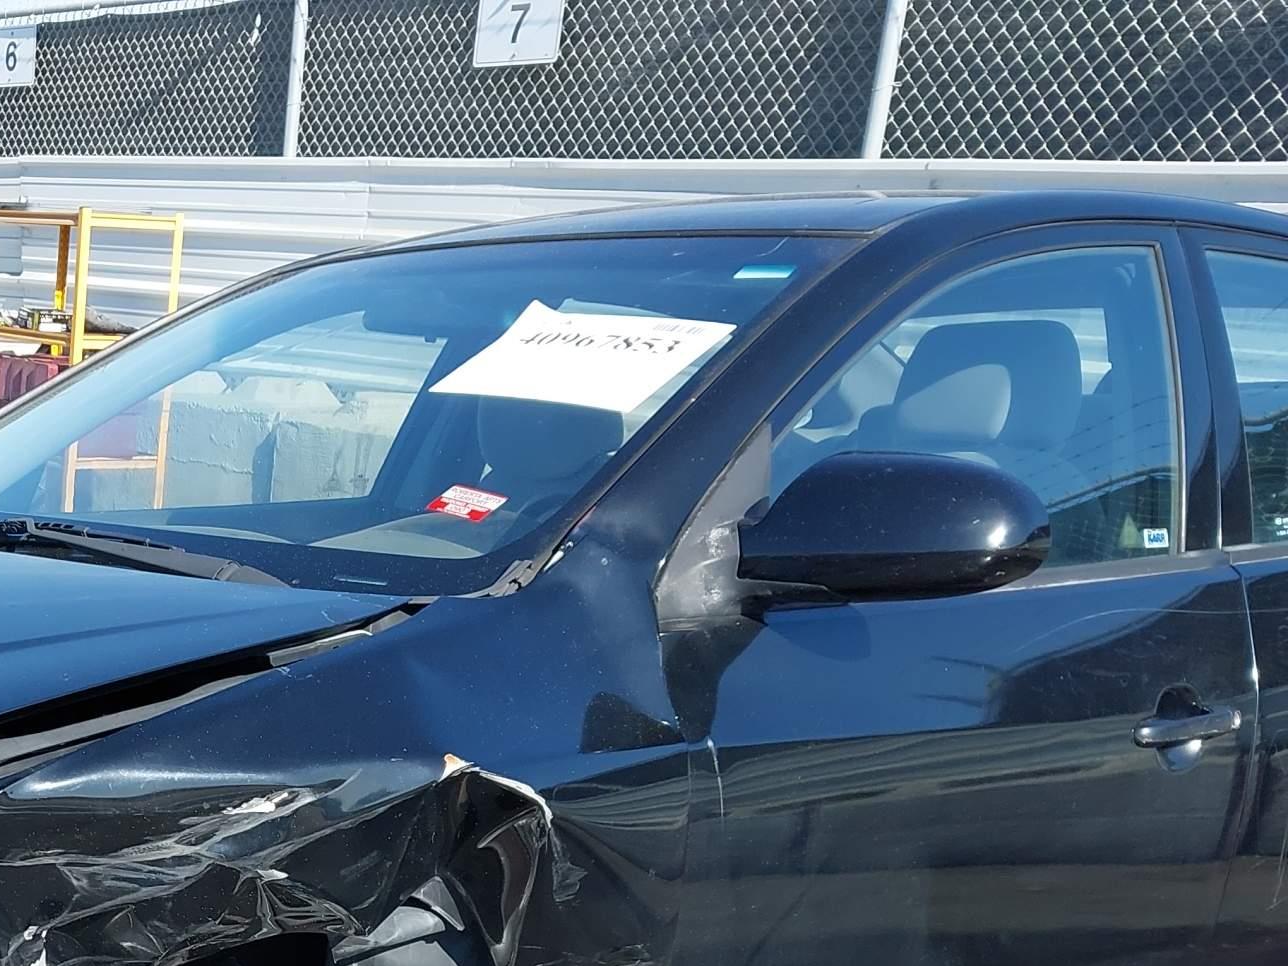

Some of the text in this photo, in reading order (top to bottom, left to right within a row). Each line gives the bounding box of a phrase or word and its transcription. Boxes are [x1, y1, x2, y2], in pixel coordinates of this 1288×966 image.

[511, 3, 531, 43] 7
[6, 41, 17, 71] 6
[520, 332, 681, 353] 40967853
